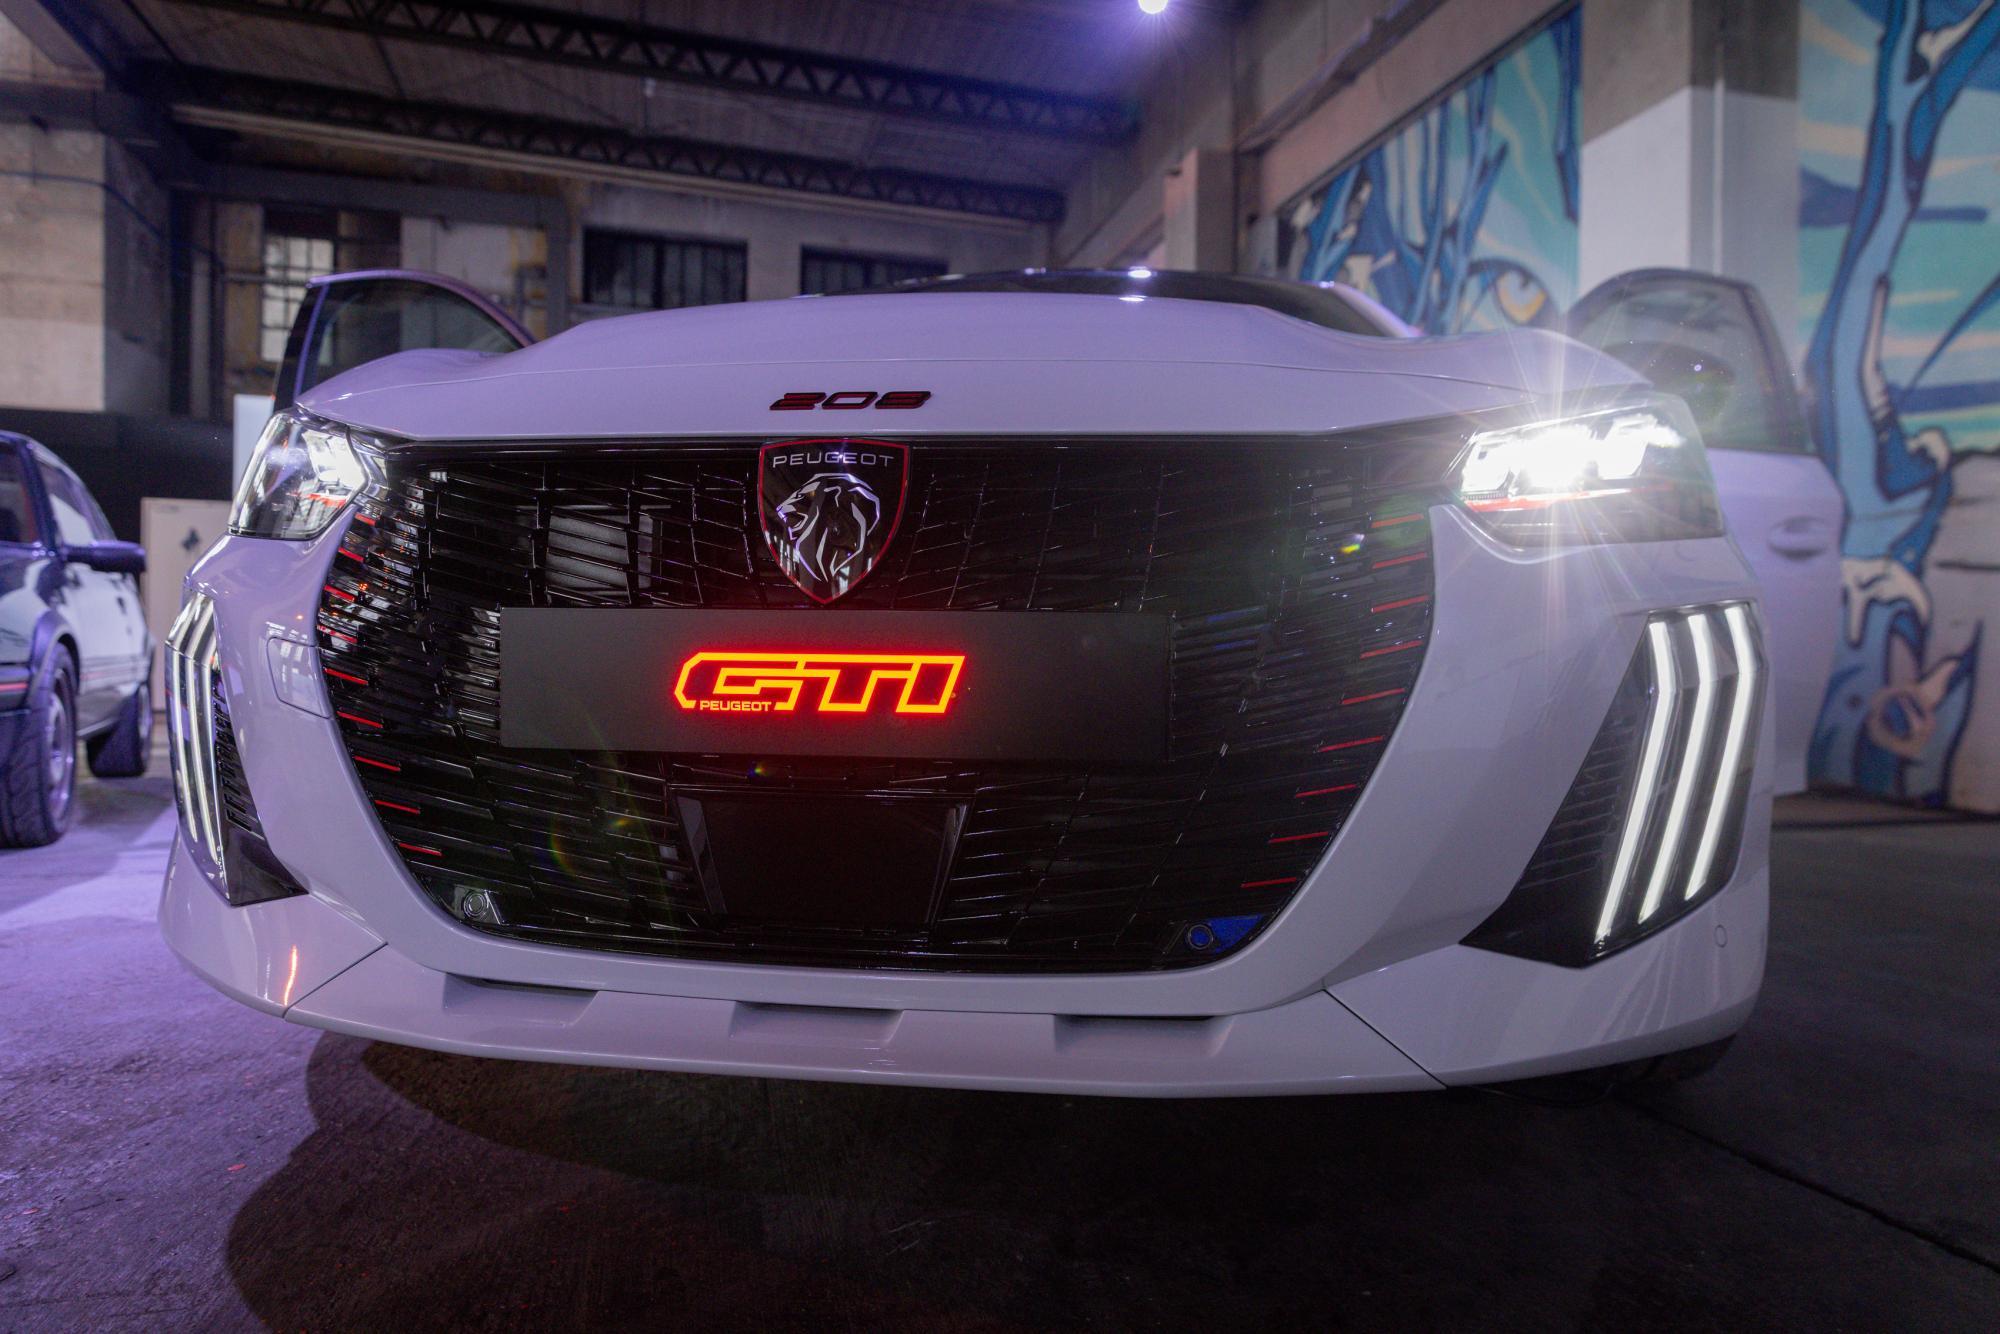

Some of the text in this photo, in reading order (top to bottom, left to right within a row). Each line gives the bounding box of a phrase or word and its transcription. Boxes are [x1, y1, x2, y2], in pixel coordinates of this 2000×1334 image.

[769, 391, 932, 411] 208
[772, 451, 894, 468] PEUGEOT
[674, 652, 966, 714] GTI
[699, 700, 773, 712] PEUGEOT
